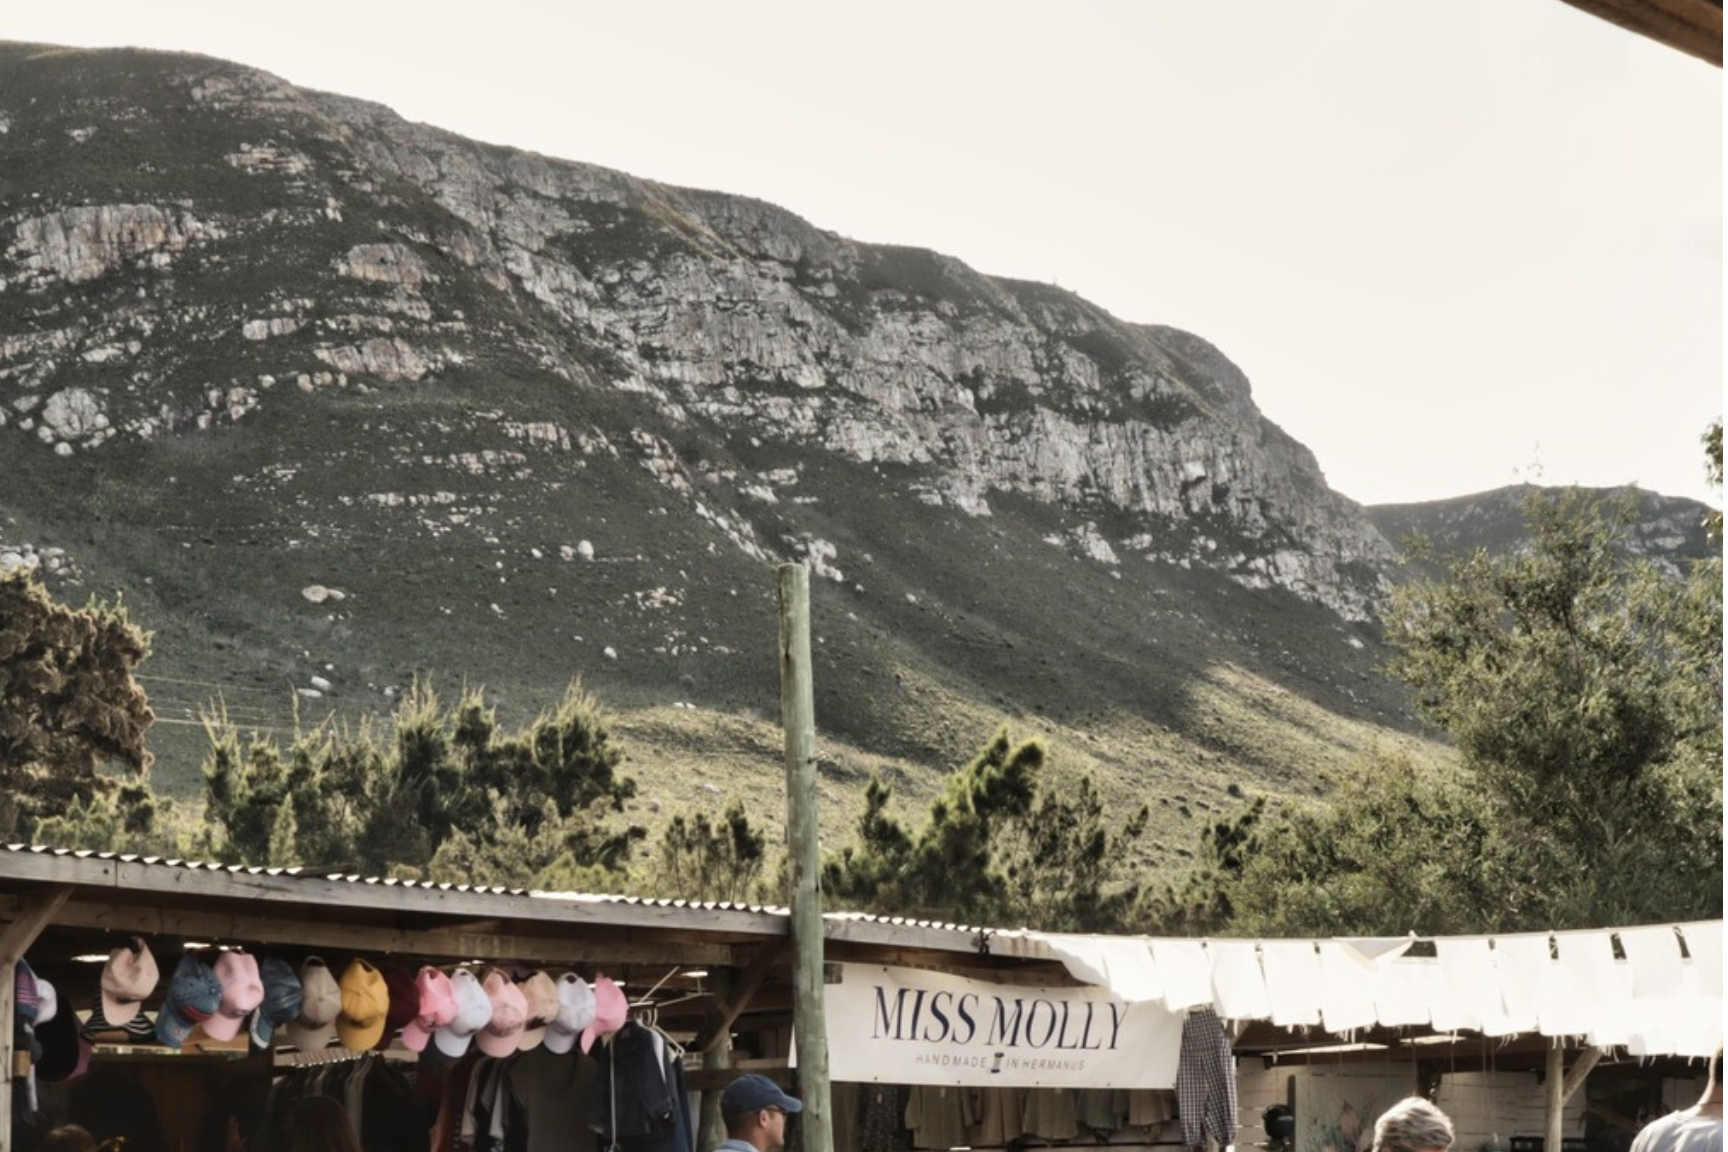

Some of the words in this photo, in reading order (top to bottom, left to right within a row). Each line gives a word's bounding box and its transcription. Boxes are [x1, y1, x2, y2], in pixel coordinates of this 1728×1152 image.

[871, 985, 979, 1046] MISS
[984, 995, 1131, 1050] MOLLY
[915, 1054, 988, 1069] HANDMADE
[1005, 1059, 1019, 1069] IN
[1021, 1059, 1085, 1071] HERMANUS
